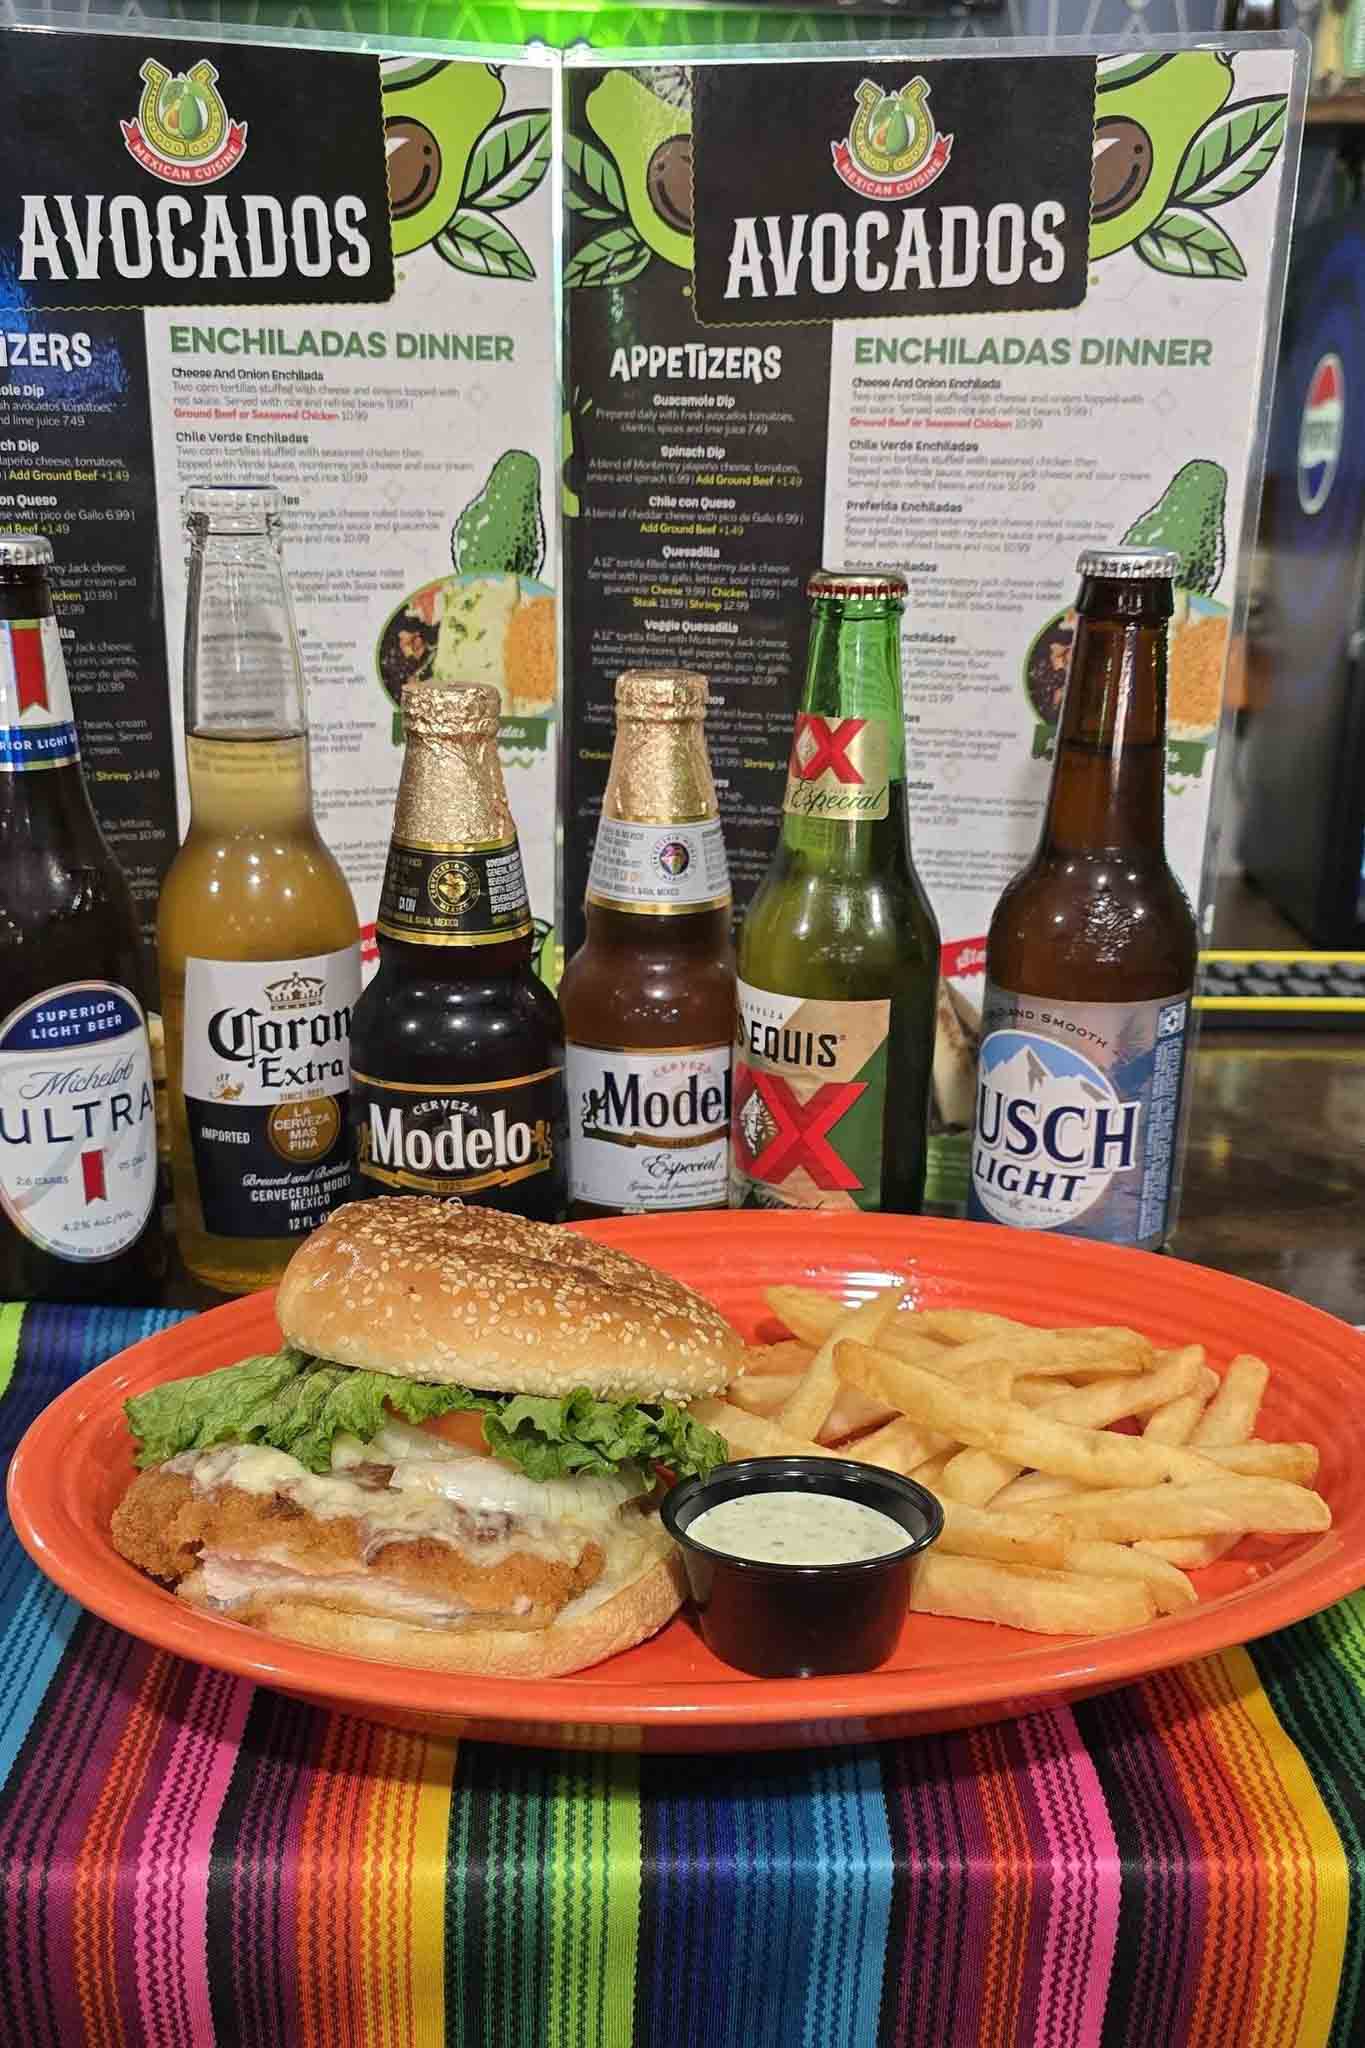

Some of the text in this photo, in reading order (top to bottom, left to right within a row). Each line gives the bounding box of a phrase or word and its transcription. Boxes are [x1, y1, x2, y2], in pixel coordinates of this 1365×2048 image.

[132, 137, 241, 180] MEXICAN CUISINE
[840, 157, 943, 196] MEXICAN CUISINE
[19, 195, 371, 280] AVOCADOS
[724, 200, 1066, 299] AVOCADOS
[0, 330, 92, 372] IZERS
[170, 326, 514, 361] ENCHILADAS DINNER
[855, 337, 1213, 366] ENCHILADAS DINNER
[172, 368, 323, 380] Cheese And Onion Enchilada
[24, 385, 44, 398] Dip
[19, 440, 39, 453] Dip
[660, 446, 726, 459] Spinach Dip
[17, 495, 57, 509] Queso
[649, 495, 736, 510] Chile con Queso
[0, 736, 68, 750] RIOR LIGHT
[792, 780, 886, 816] Especial
[36, 1001, 115, 1023] SUPERIOR
[31, 1014, 122, 1039] LIGHT BEER
[208, 1006, 351, 1068] Coron
[1041, 1014, 1108, 1048] SMOOTH
[750, 1021, 838, 1067] EQUIS
[19, 1052, 136, 1100] Michelob
[259, 1056, 343, 1088] Extra
[292, 1106, 311, 1117] LA
[412, 1099, 479, 1117] CERVEZA
[603, 1069, 731, 1128] Model
[0, 1080, 153, 1144] ULTRA
[274, 1113, 331, 1131] CERVEZA
[202, 1127, 251, 1144] IMPORTED
[369, 1103, 531, 1170] Modelo
[979, 1083, 1138, 1169] USCH
[289, 1139, 319, 1151] FINA
[242, 1172, 291, 1187] Brewed
[291, 1169, 314, 1184] and
[641, 1152, 721, 1180] Especial
[976, 1151, 1086, 1202] LIGHT
[16, 1176, 32, 1186] 2.6
[251, 1183, 320, 1202] CERVECERIA
[290, 1195, 331, 1211] MEXICO
[289, 1217, 301, 1230] 12
